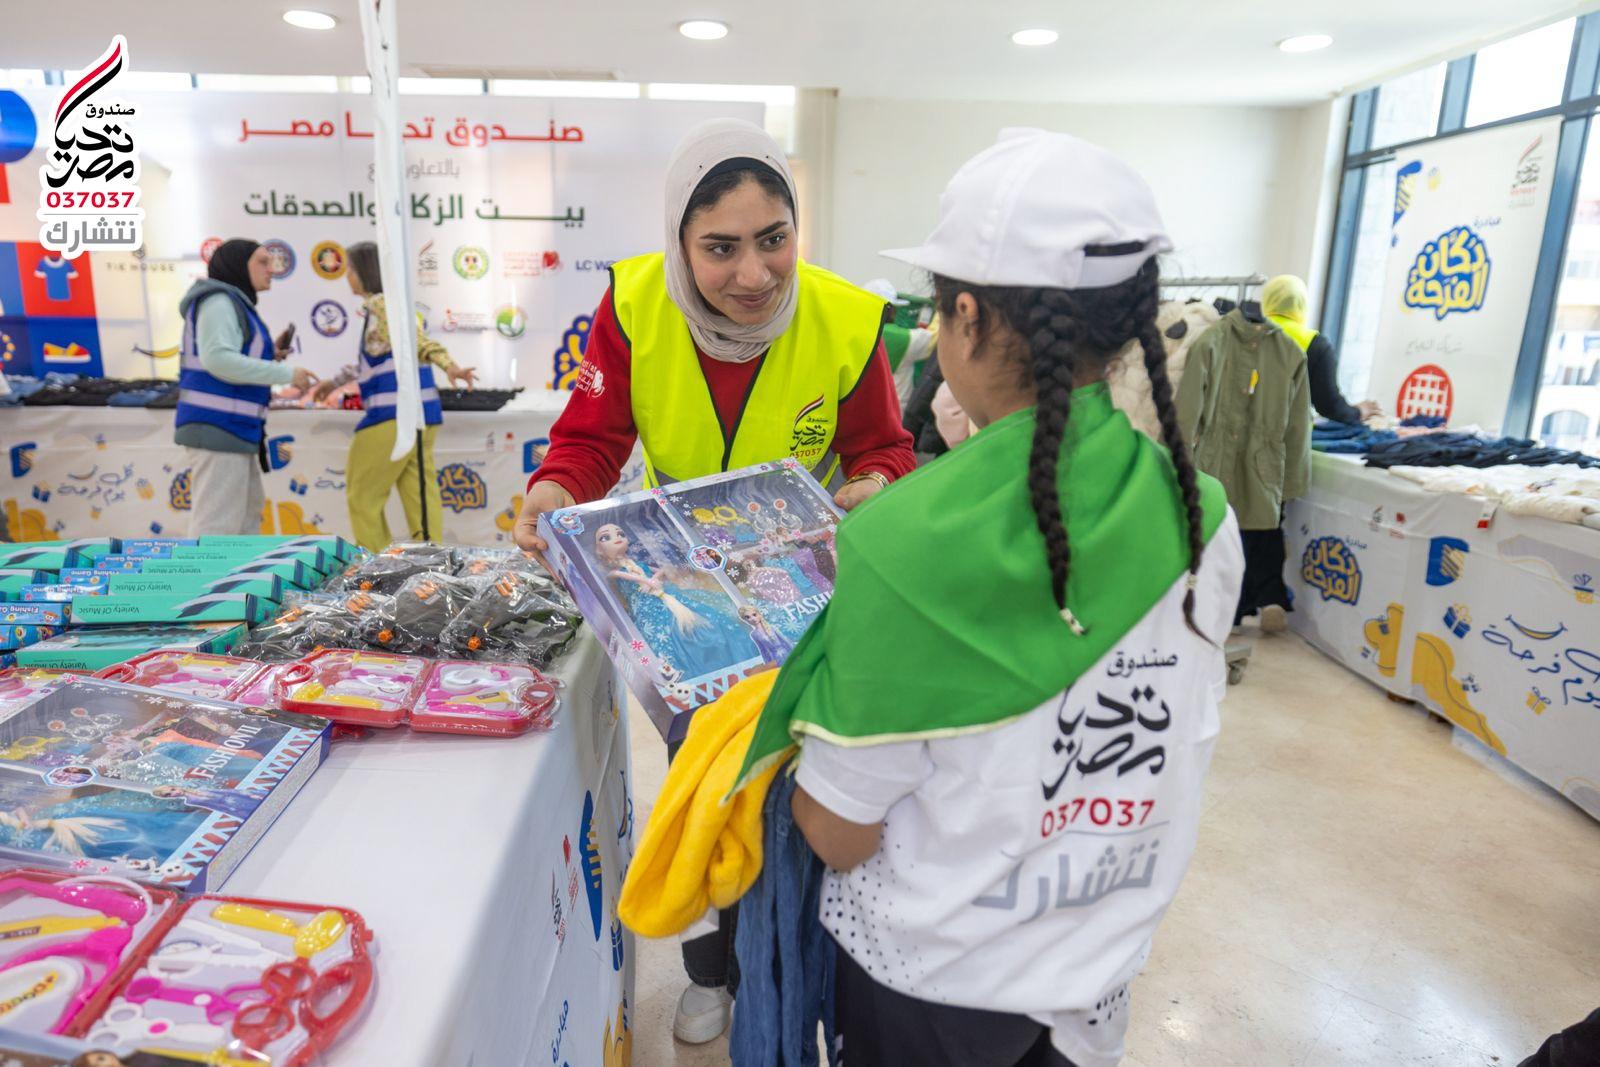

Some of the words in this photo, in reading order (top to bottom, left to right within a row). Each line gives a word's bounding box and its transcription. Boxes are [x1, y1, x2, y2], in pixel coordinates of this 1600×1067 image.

[239, 115, 334, 143] مصر
[346, 111, 434, 140] تحا
[446, 117, 584, 147] صندوق
[403, 158, 460, 179] بالتعاو
[394, 192, 464, 227] الزكا
[476, 194, 584, 229] بيت
[102, 607, 112, 615] Of
[113, 606, 140, 614] Variety
[783, 590, 834, 622] FASH
[1107, 649, 1178, 678] صندوق
[1041, 797, 1155, 838] 037037
[971, 839, 1161, 925] نتشارك
